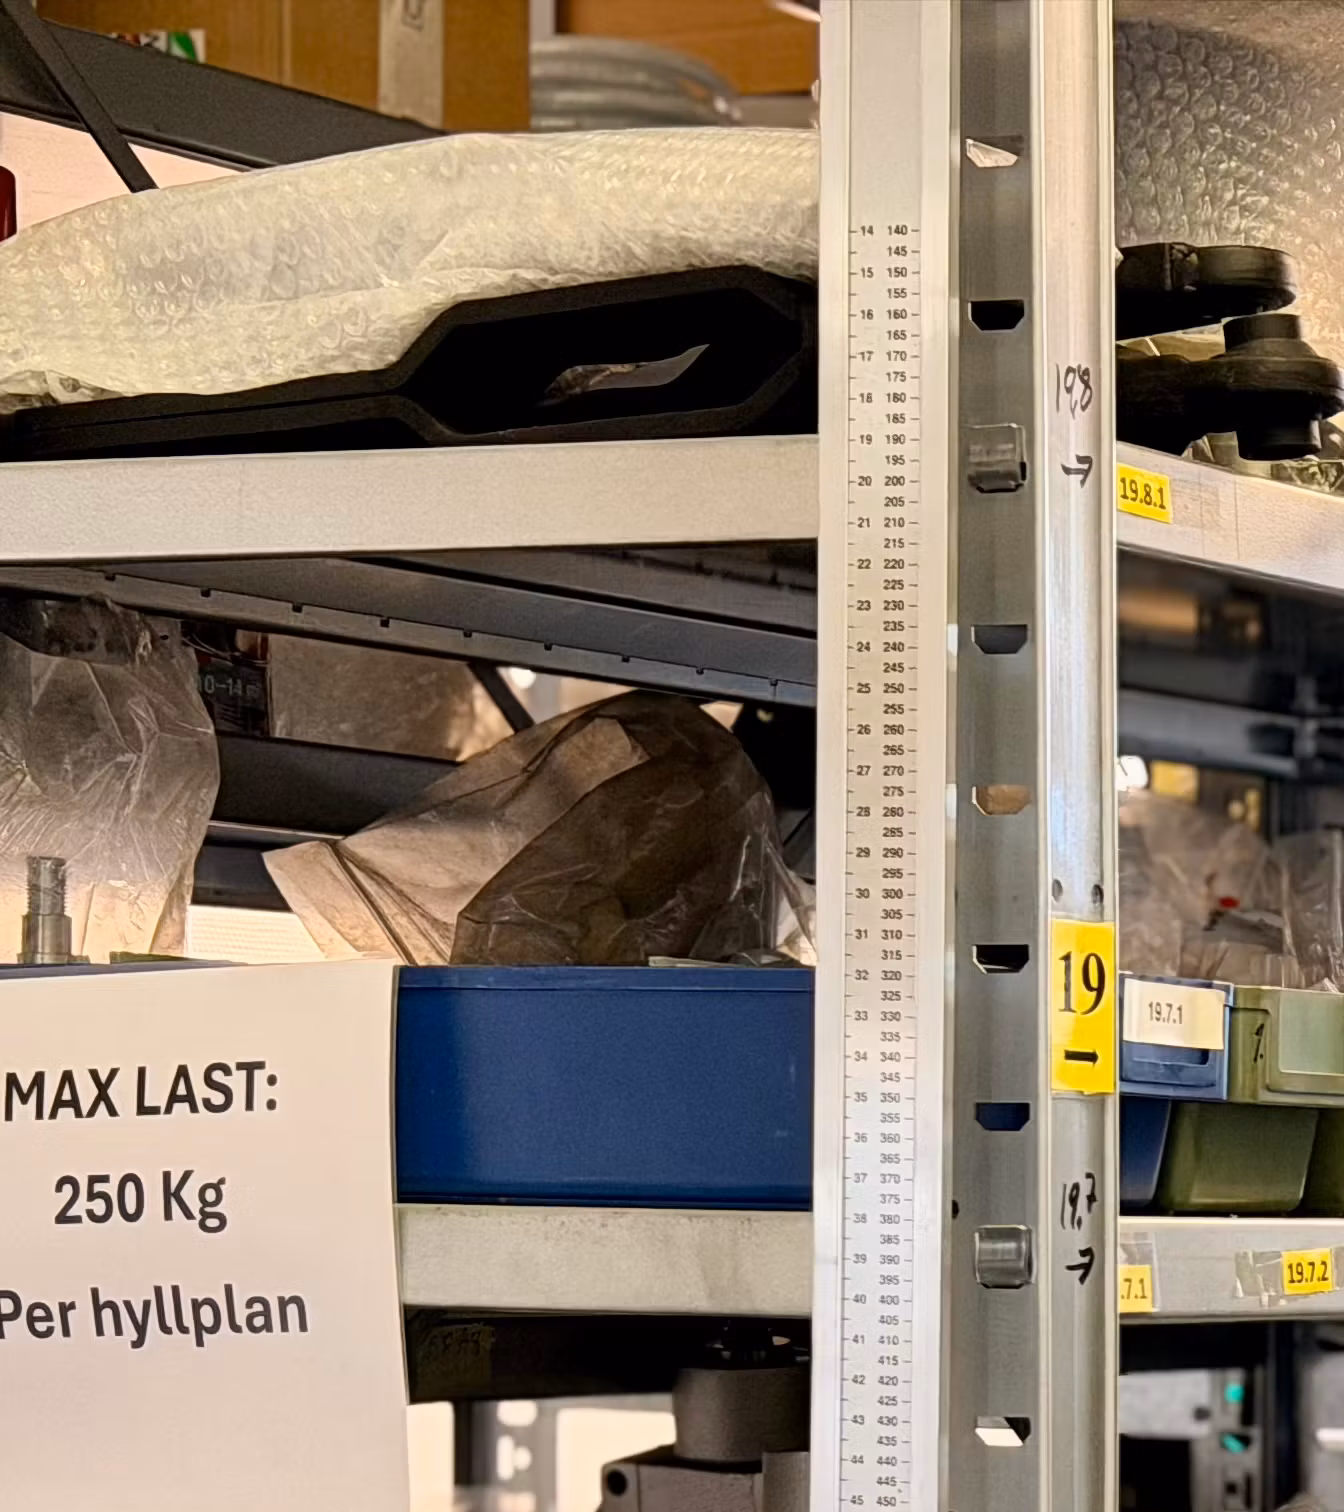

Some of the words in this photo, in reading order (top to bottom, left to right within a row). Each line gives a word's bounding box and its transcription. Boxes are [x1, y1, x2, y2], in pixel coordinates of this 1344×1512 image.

[859, 224, 875, 237] 14
[887, 224, 909, 236] 140
[860, 266, 875, 279] 15
[886, 266, 908, 279] 150
[859, 350, 875, 362] 17
[885, 349, 908, 362] 170
[858, 392, 873, 404] 18
[885, 391, 907, 404] 180
[857, 475, 873, 487] 20
[884, 475, 906, 487] 200
[1118, 476, 1167, 511] 19.8.1
[856, 516, 871, 529] 21
[883, 516, 906, 529] 210
[856, 599, 872, 612] 23
[882, 599, 905, 612] 230
[856, 640, 871, 653] 24
[882, 641, 905, 653] 240
[856, 723, 872, 736] 26
[883, 723, 905, 736] 260
[855, 764, 872, 777] 27
[882, 764, 905, 777] 270
[855, 846, 871, 859] 29
[881, 846, 904, 859] 290
[855, 887, 871, 900] 30
[881, 887, 904, 900] 300
[854, 968, 870, 981] 32
[880, 969, 903, 982] 320
[1058, 950, 1106, 1016] 19
[853, 1009, 869, 1022] 33
[880, 1010, 902, 1023] 330
[1148, 1000, 1184, 1026] 19.7.1
[3, 1066, 121, 1122] MAX
[135, 1060, 280, 1118] LAST:
[853, 1091, 869, 1103] 35
[879, 1091, 901, 1104] 350
[53, 1172, 146, 1227] 250
[161, 1168, 229, 1235] Kg
[852, 1212, 868, 1224] 38
[879, 1213, 901, 1225] 380
[852, 1252, 868, 1265] 39
[879, 1254, 901, 1266] 390
[1286, 1261, 1329, 1285] 19.7.2
[1120, 1277, 1149, 1301] .7.1
[0, 1288, 77, 1341] Per
[91, 1283, 311, 1348] hyllplan
[851, 1333, 865, 1345] 41
[877, 1334, 900, 1346] 410
[849, 1454, 865, 1465] 44
[876, 1455, 898, 1467] 440
[849, 1494, 865, 1506] 45
[875, 1495, 897, 1508] 450
